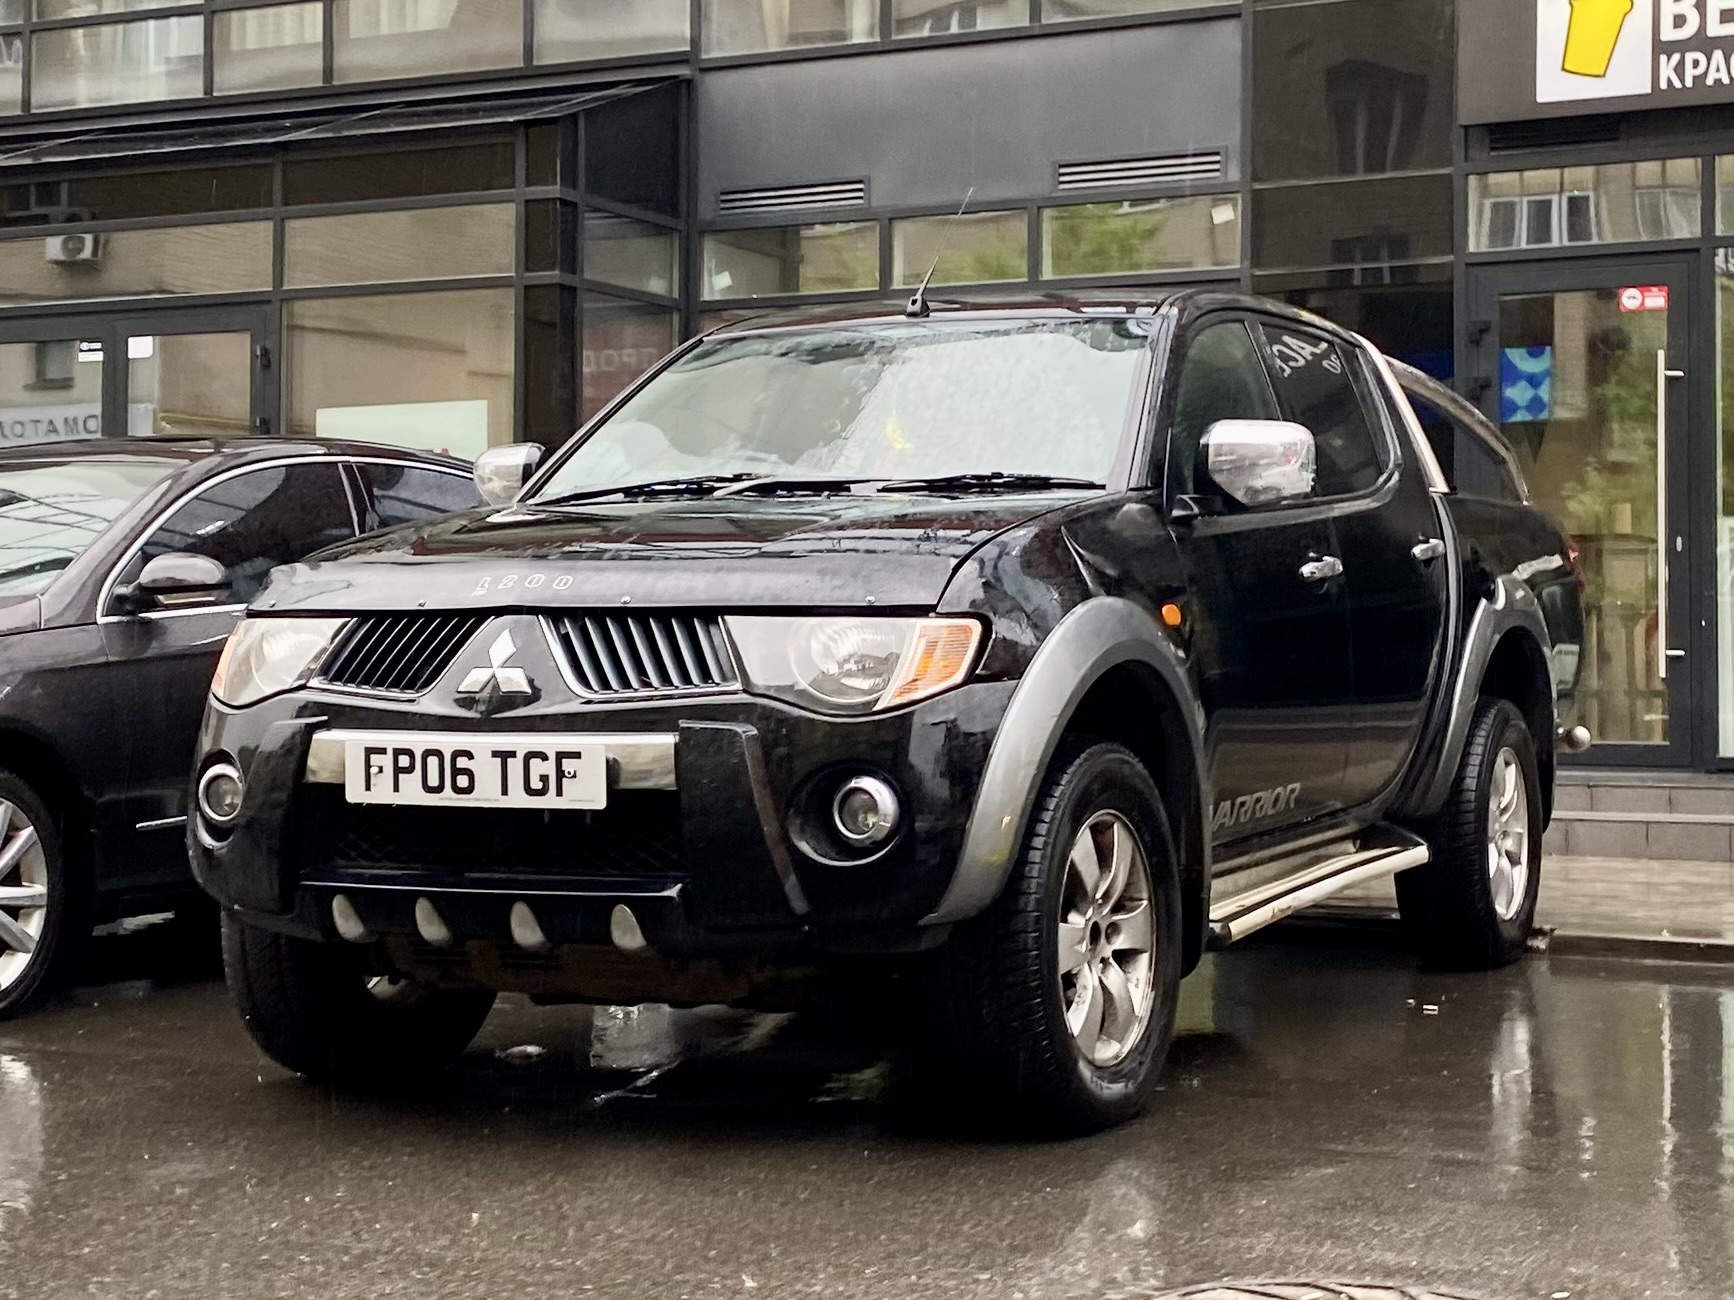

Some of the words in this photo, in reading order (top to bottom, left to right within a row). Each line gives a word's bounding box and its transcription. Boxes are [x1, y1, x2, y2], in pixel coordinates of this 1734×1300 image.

[1659, 49, 1734, 90] КРА
[472, 573, 574, 596] L200
[364, 746, 475, 795] FP06
[491, 750, 582, 797] TGF
